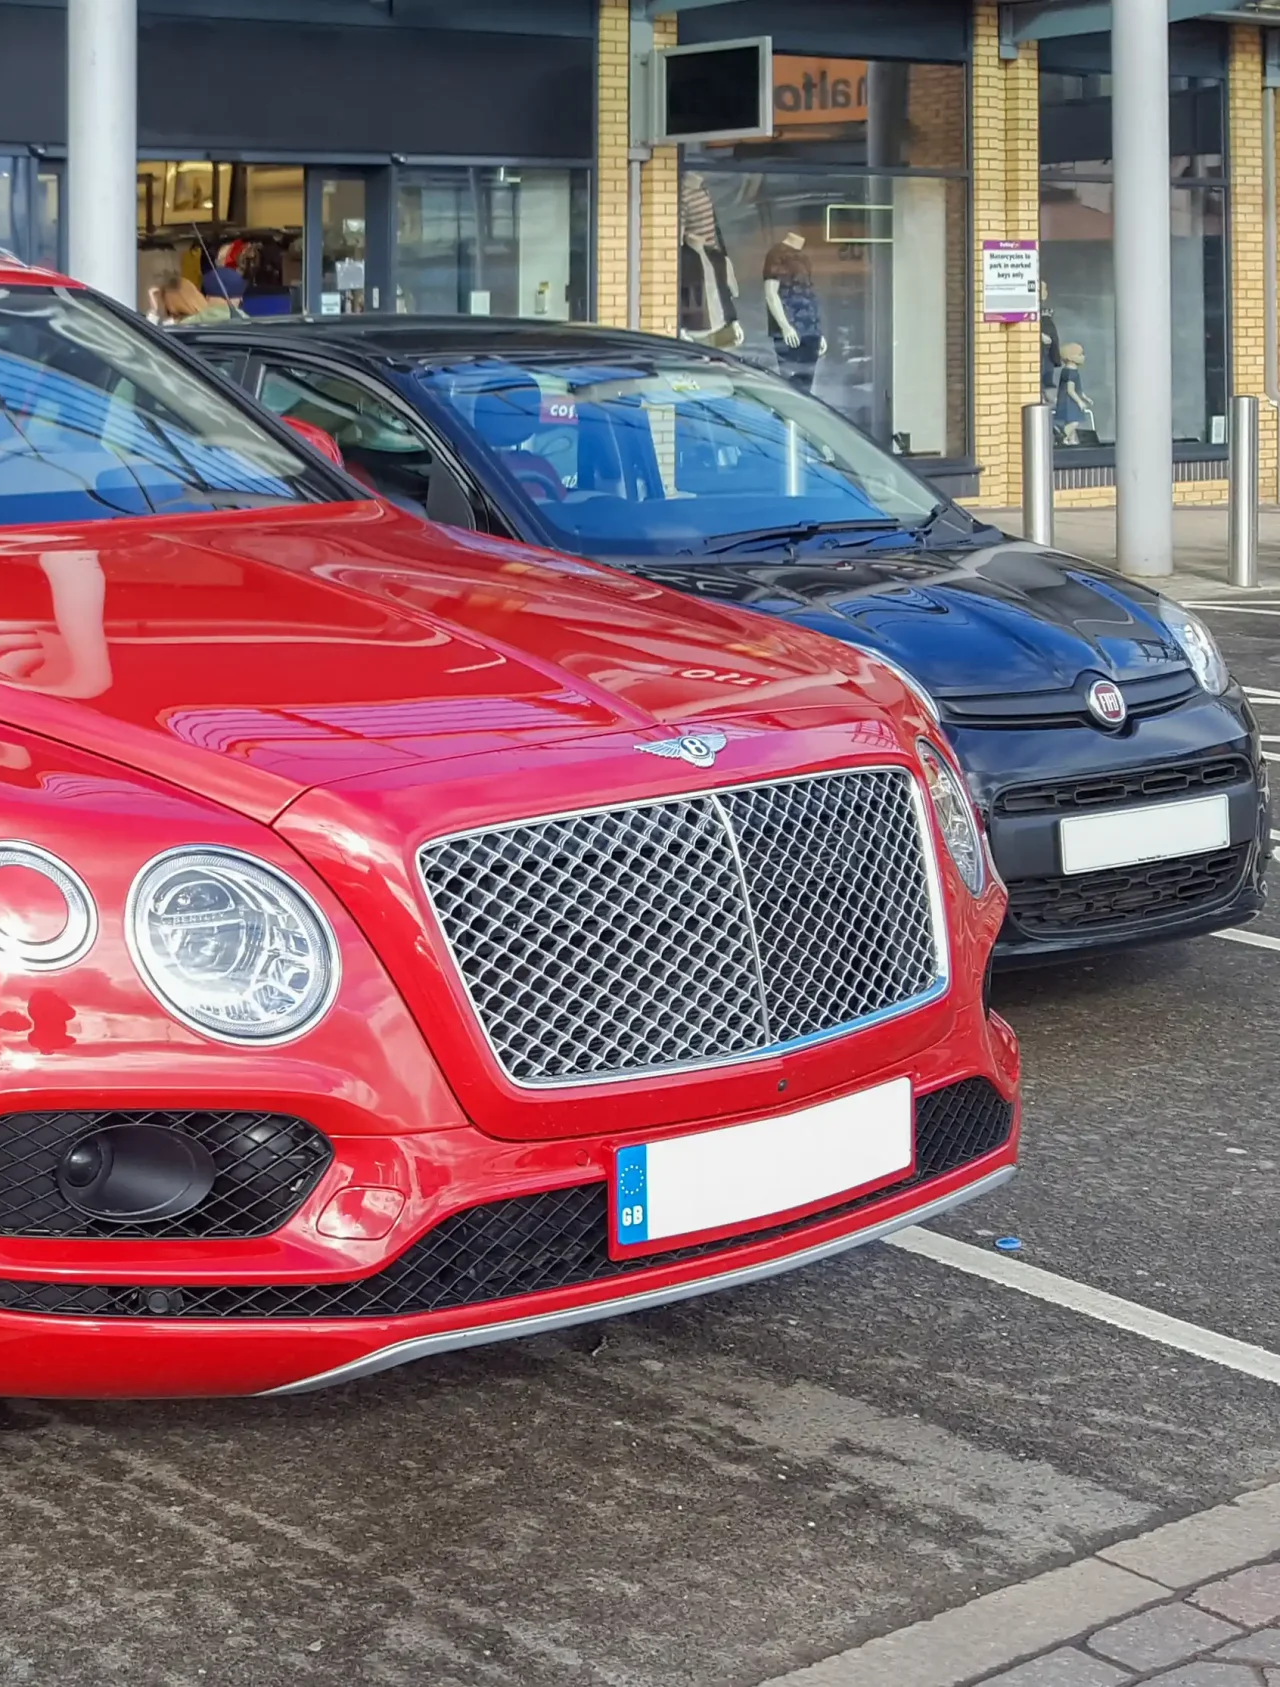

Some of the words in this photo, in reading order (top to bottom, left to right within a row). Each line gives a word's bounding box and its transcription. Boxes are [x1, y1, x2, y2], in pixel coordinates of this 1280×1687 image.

[989, 262, 1002, 270] park
[550, 404, 578, 419] COS
[1097, 692, 1120, 712] FIAT
[622, 1205, 644, 1227] GB
